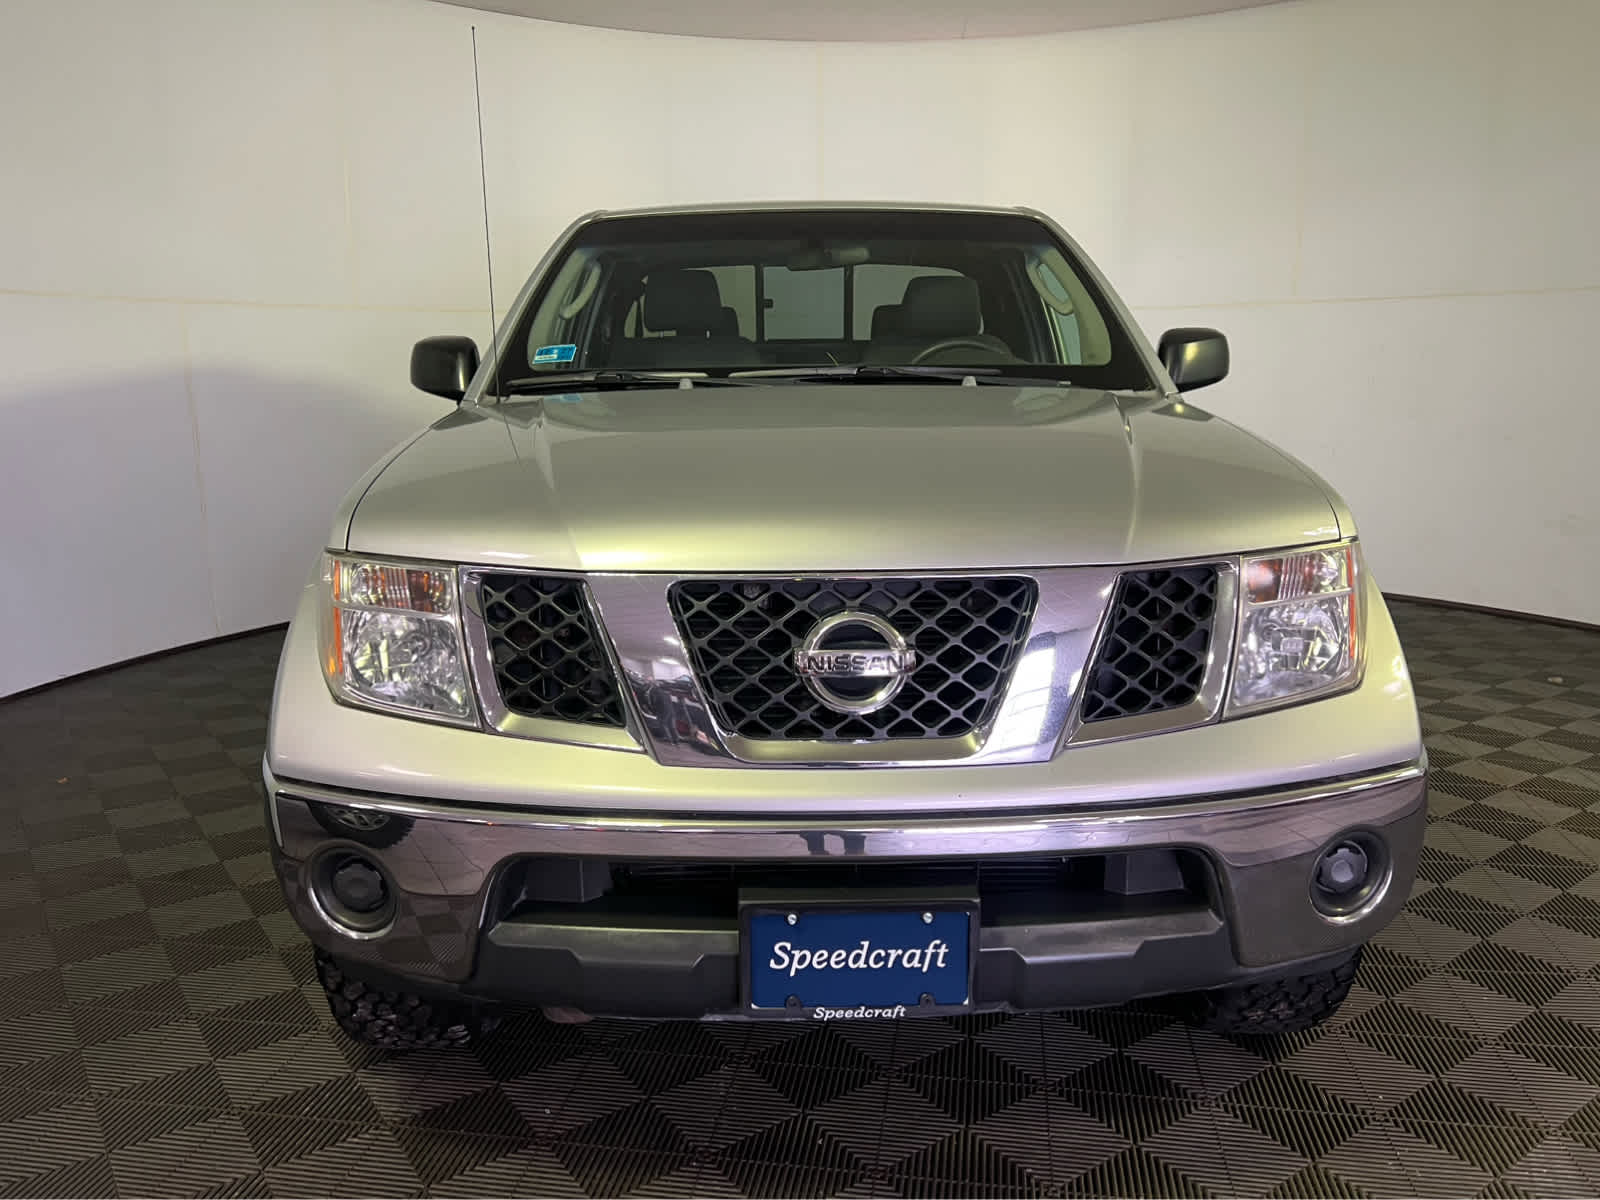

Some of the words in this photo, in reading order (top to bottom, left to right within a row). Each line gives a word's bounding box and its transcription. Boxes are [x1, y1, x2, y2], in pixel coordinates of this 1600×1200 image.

[807, 654, 903, 672] NISSAN
[769, 939, 949, 977] Speedcraft
[813, 1004, 907, 1021] Speedcraft
